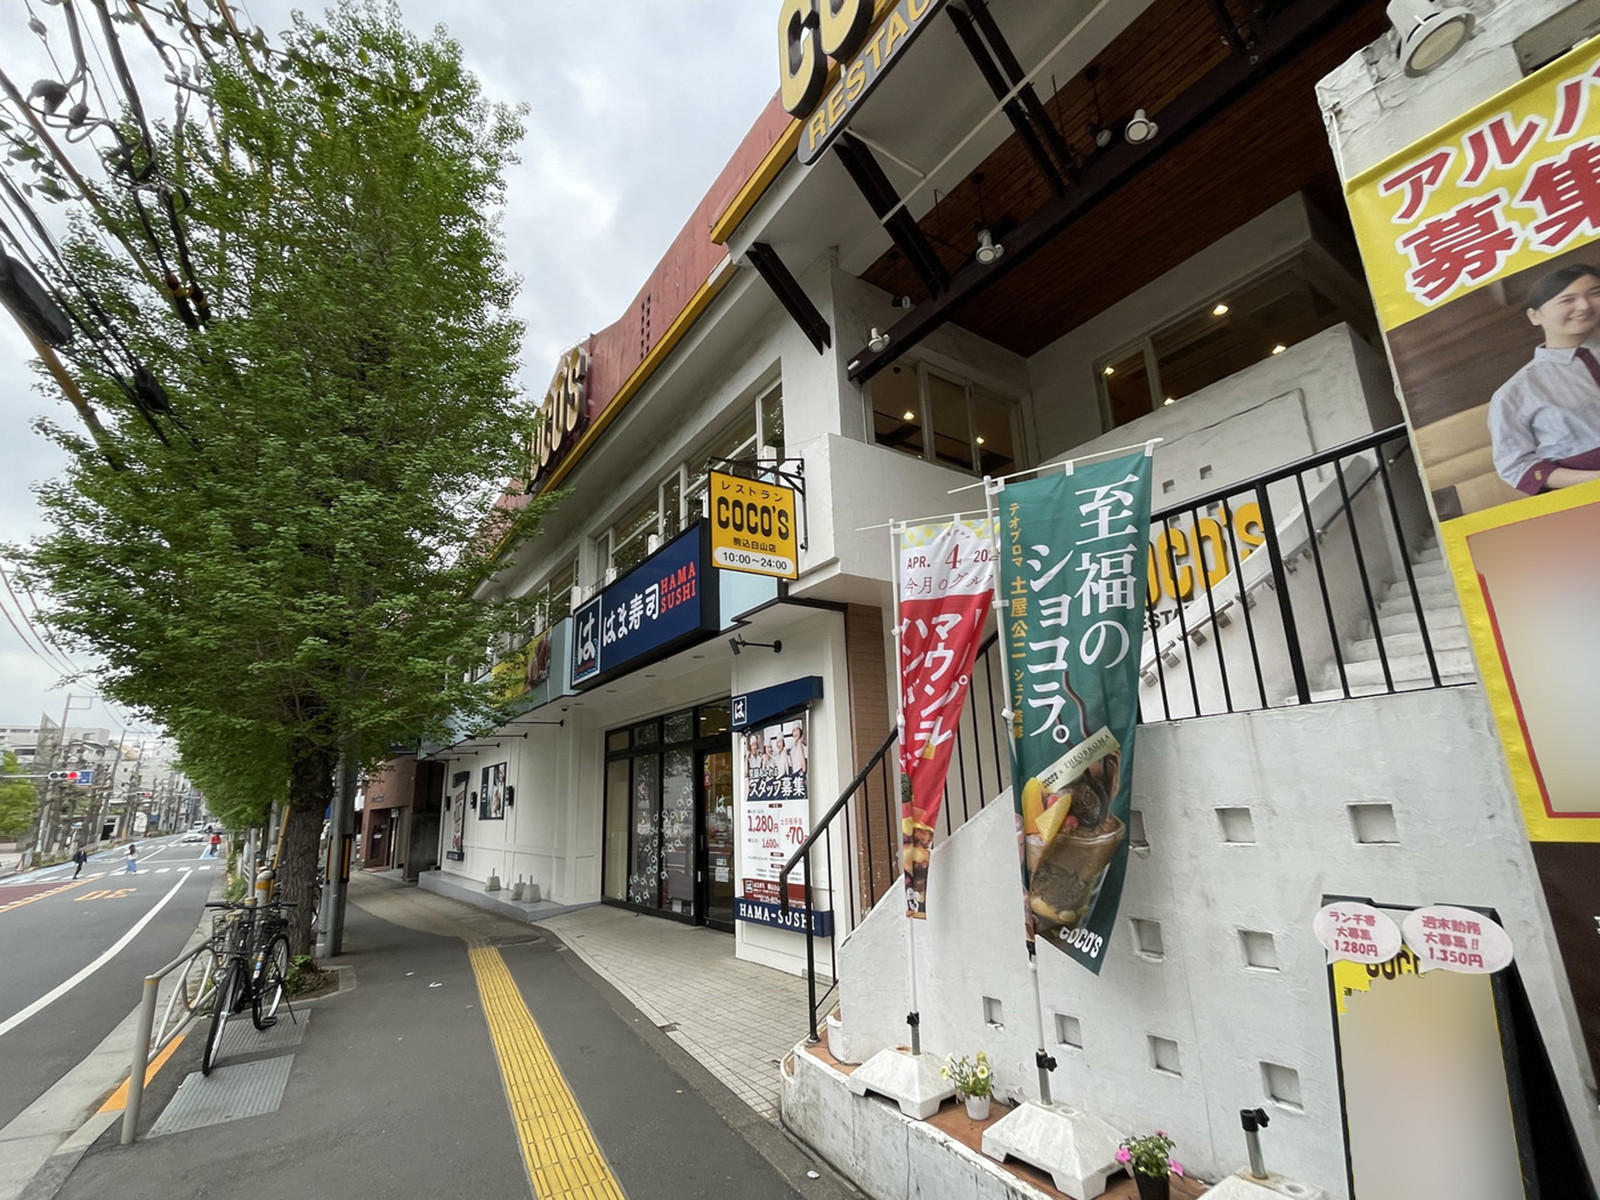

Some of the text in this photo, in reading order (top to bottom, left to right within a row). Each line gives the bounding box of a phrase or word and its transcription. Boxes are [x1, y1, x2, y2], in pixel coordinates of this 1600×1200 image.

[721, 480, 783, 502] レストラン
[717, 496, 789, 541] COCO'S
[1009, 502, 1024, 568] テオブロマ
[906, 555, 931, 570] APR.
[945, 543, 962, 570] 4
[1074, 473, 1140, 669] 至福の
[660, 561, 697, 595] HAMA
[660, 579, 697, 614] SUSHI
[602, 582, 660, 648] はま寿司
[577, 611, 596, 666] は
[749, 776, 806, 798] スタッフ募集
[1059, 926, 1104, 959] COCO'S
